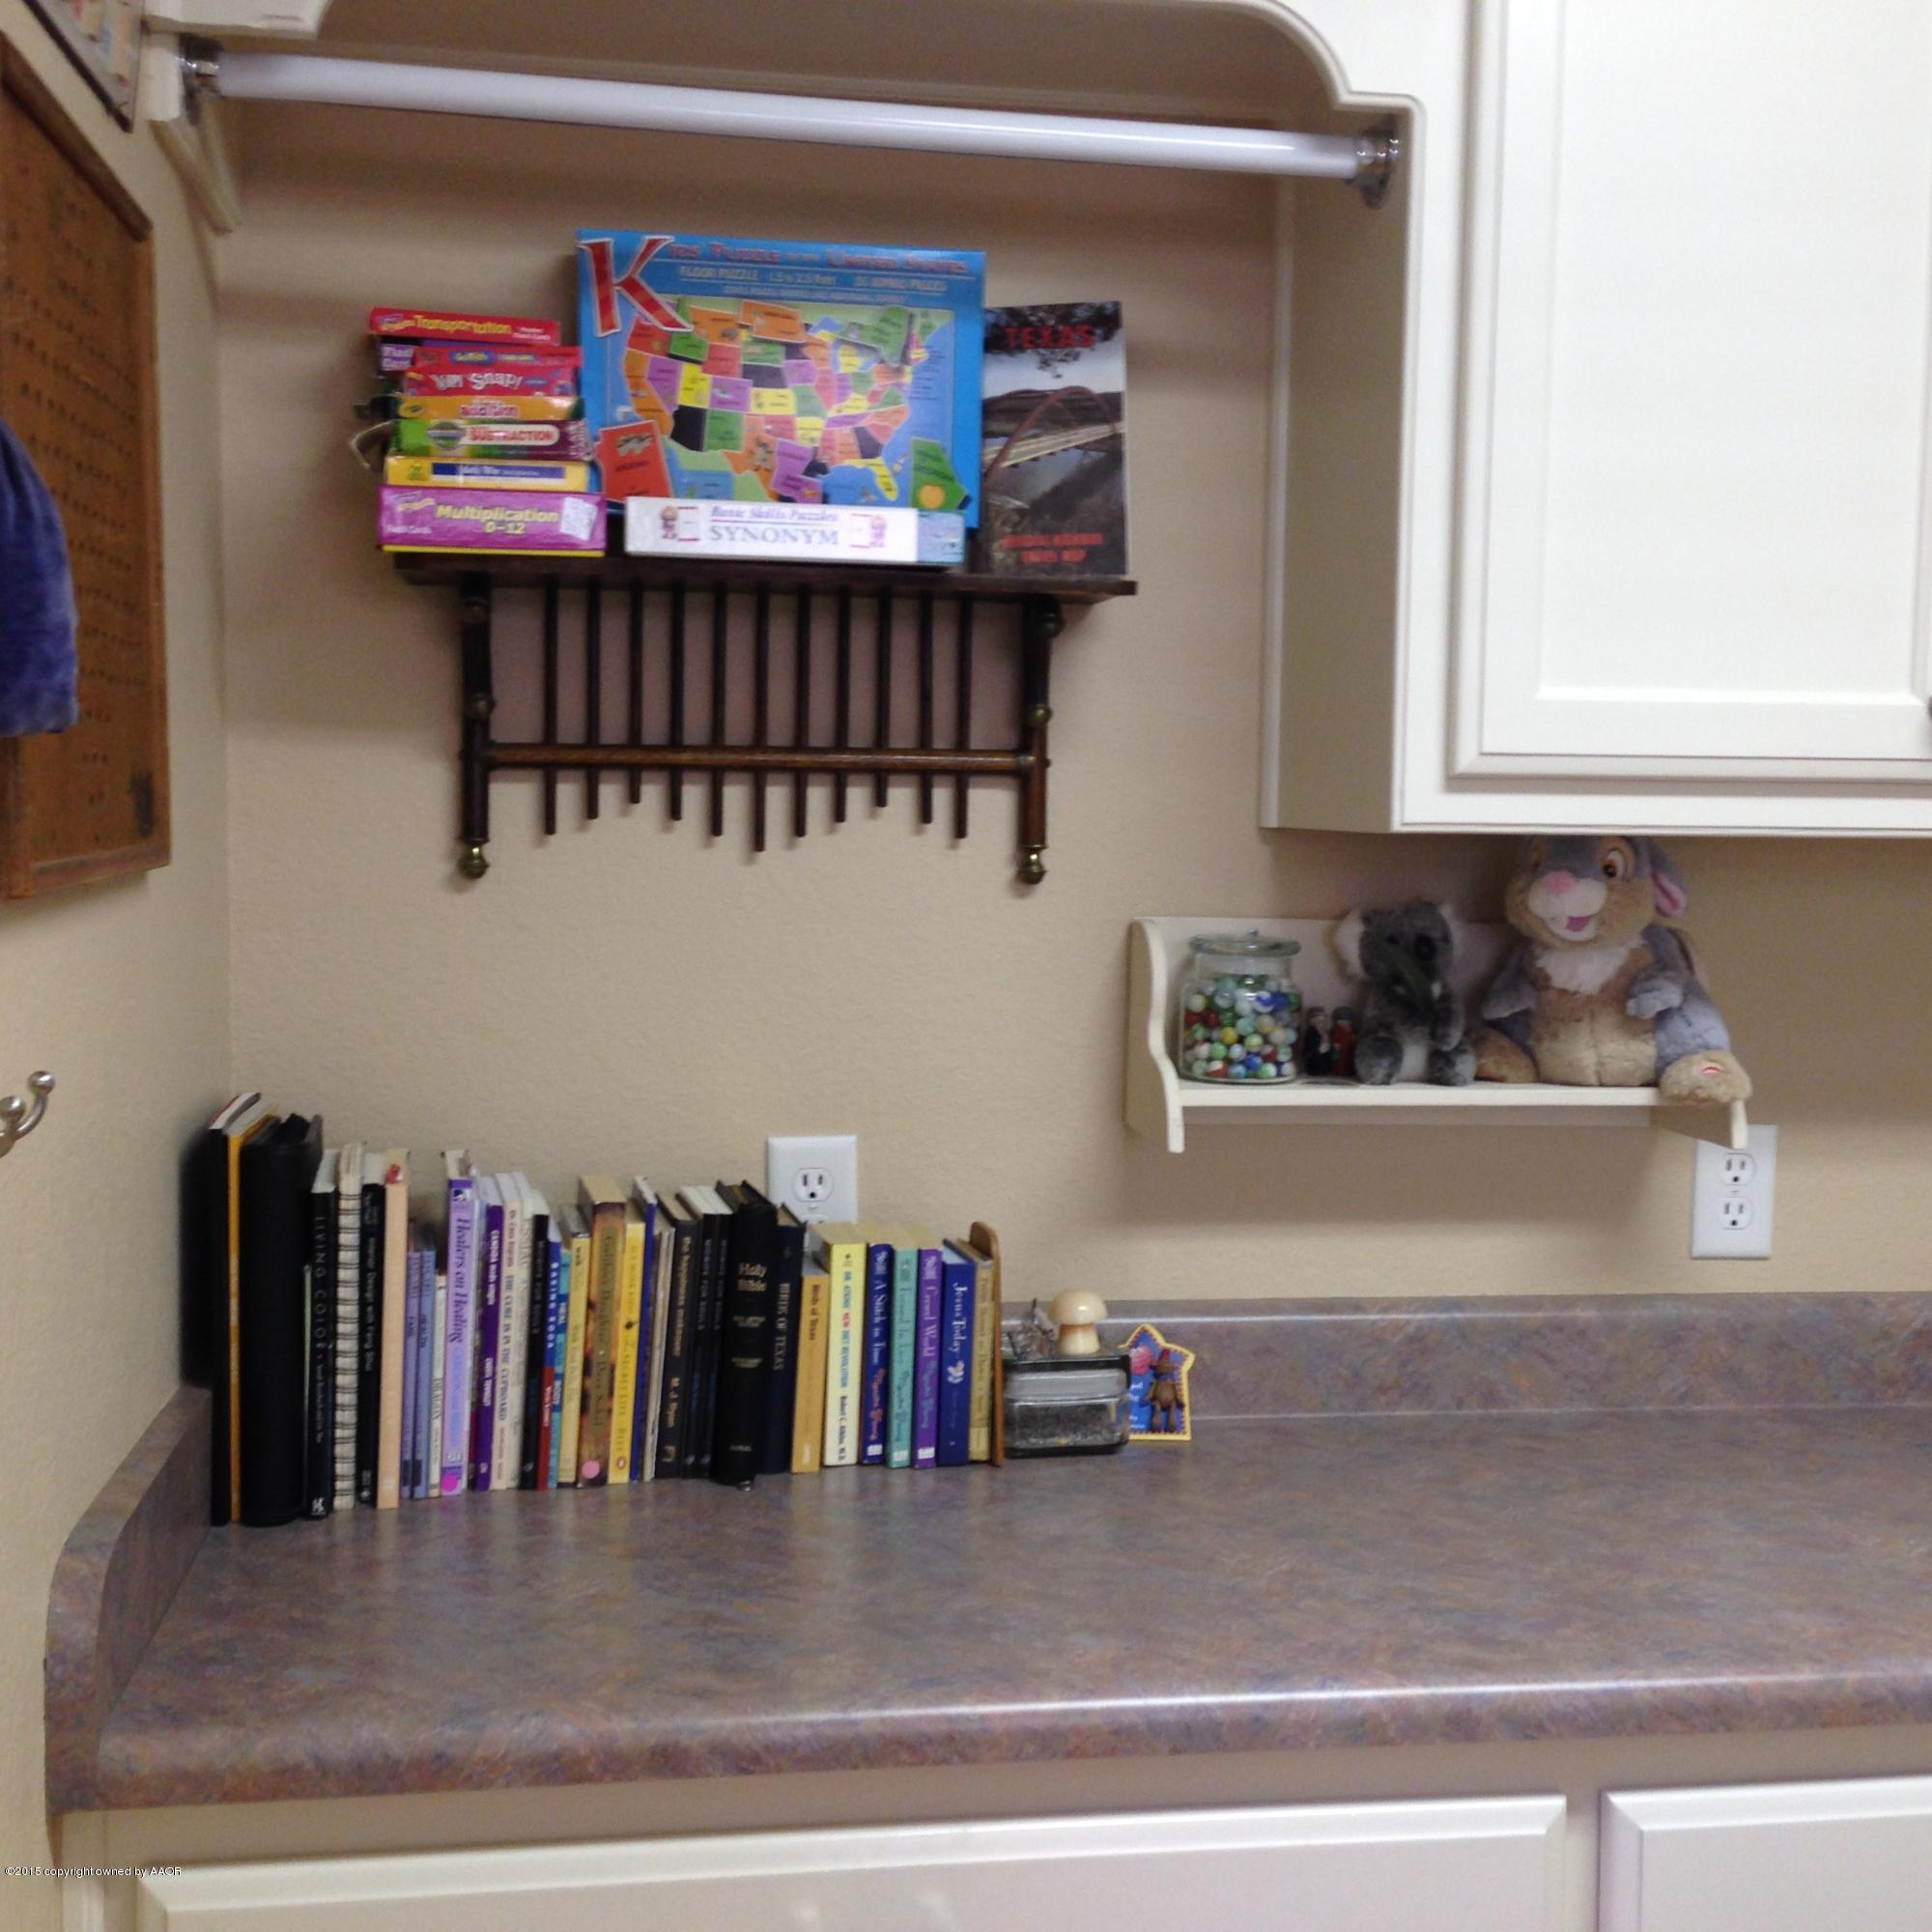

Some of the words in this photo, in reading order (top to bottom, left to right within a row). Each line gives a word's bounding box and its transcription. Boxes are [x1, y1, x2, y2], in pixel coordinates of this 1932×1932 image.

[1005, 325, 1094, 349] TEXAS
[437, 504, 558, 522] Multiplication
[709, 525, 839, 545] SYNONYM
[315, 1215, 327, 1278] LIVING
[455, 1217, 472, 1269] Healers
[454, 1270, 465, 1290] on
[739, 1263, 768, 1277] Holy
[874, 1279, 887, 1292] A
[365, 1271, 377, 1303] Design
[549, 1262, 558, 1310] BAKING
[776, 1282, 791, 1315] BIRDS
[811, 1283, 822, 1307] Birds
[952, 1282, 969, 1318] Jesus
[315, 1289, 327, 1350] COLOR
[448, 1292, 469, 1344] Healing
[810, 1307, 821, 1318] of
[872, 1293, 888, 1324] Stitch
[546, 1316, 556, 1350] SODA
[775, 1317, 788, 1332] OF
[809, 1318, 820, 1342] Texas
[947, 1319, 967, 1353] Today
[773, 1335, 788, 1372] TEXAS
